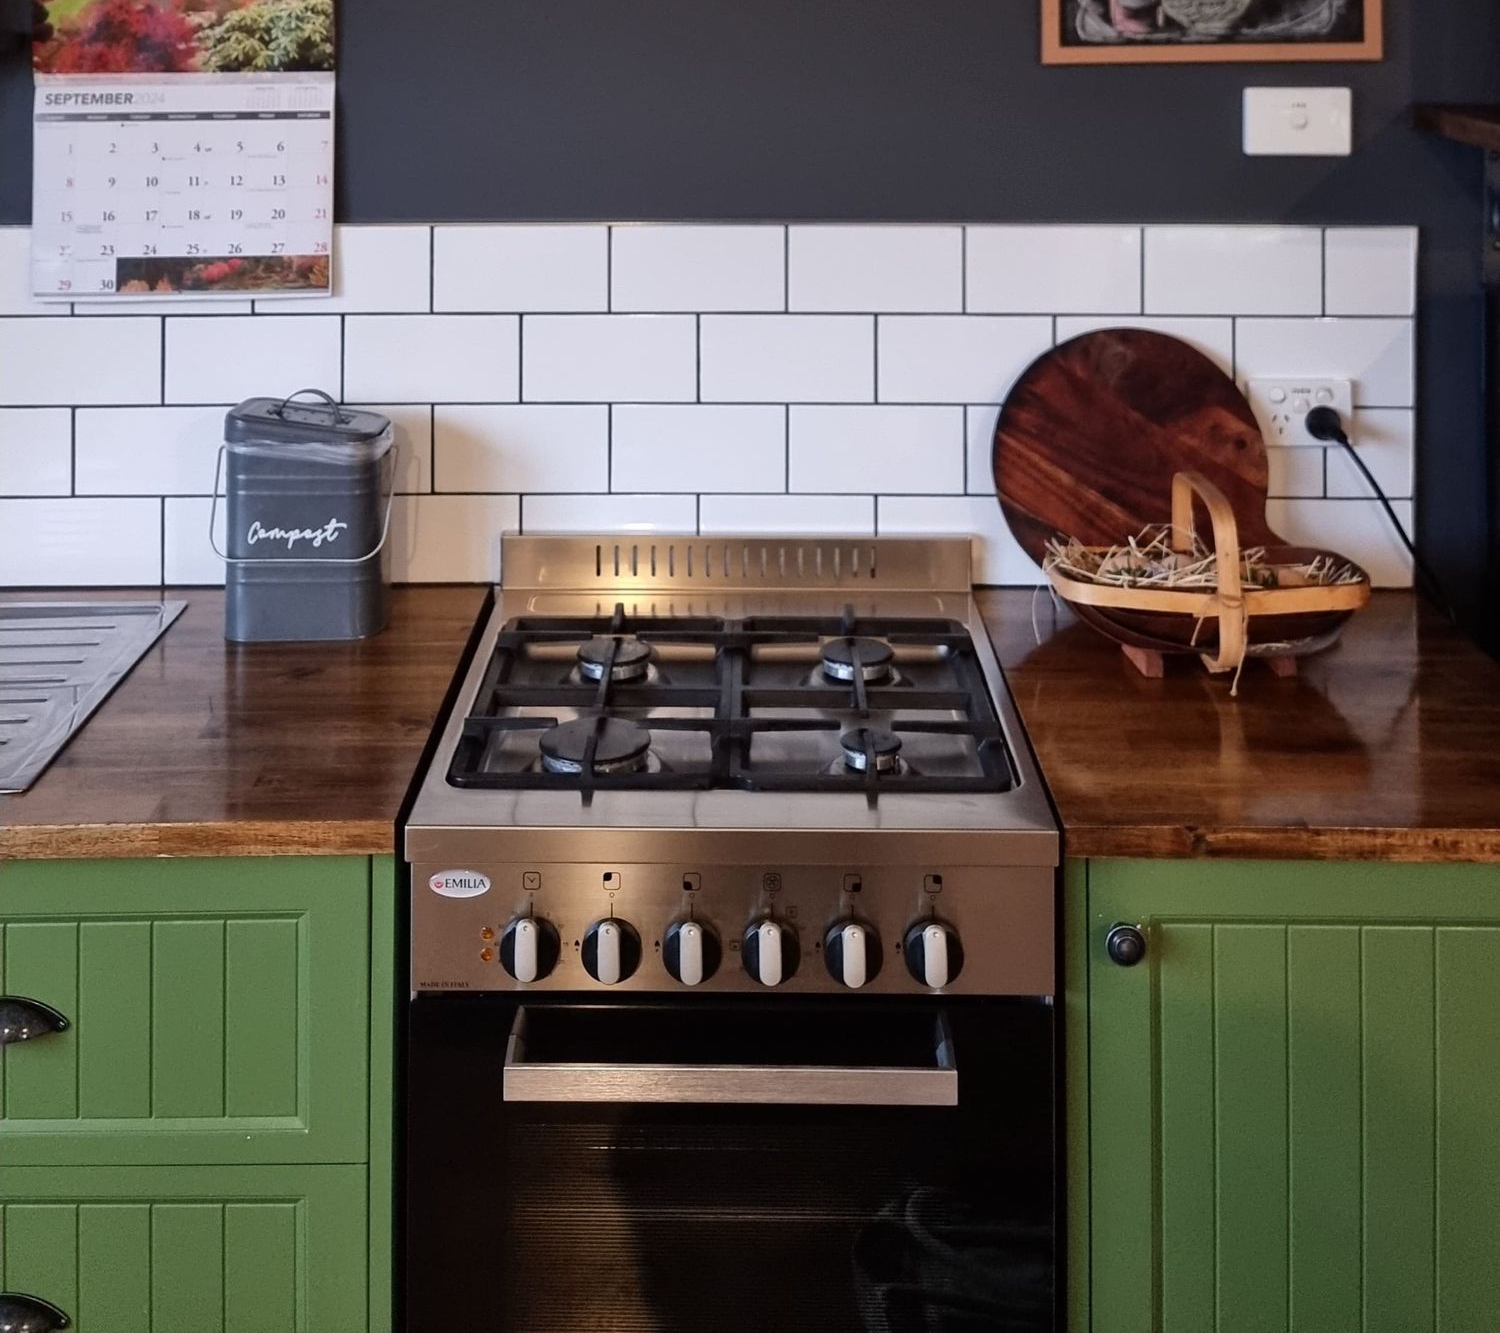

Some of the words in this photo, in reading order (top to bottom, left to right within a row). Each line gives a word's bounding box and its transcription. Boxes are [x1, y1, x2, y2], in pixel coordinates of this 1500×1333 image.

[44, 92, 134, 106] SEPTEMBER
[109, 142, 117, 154] 2
[151, 142, 159, 154] 3
[193, 142, 201, 153] 4
[236, 141, 244, 153] 5
[276, 141, 285, 152] 6
[66, 177, 75, 188] 8
[108, 177, 116, 188] 9
[145, 176, 159, 188] 10
[188, 175, 200, 187] 11
[230, 174, 244, 187] 12
[273, 174, 286, 187] 13
[315, 174, 329, 186] 14
[60, 211, 73, 223] 15
[102, 210, 116, 223] 16
[145, 210, 159, 222] 17
[187, 209, 201, 221] 18
[230, 209, 243, 221] 19
[271, 208, 286, 220] 20
[315, 208, 327, 220] 21
[100, 244, 115, 257] 23
[142, 244, 157, 256] 24
[185, 243, 200, 255] 25
[227, 242, 243, 255] 26
[271, 242, 285, 255] 27
[313, 241, 329, 254] 28
[57, 279, 73, 292] 29
[99, 279, 115, 291] 30
[247, 517, 348, 551] Compost
[445, 878, 487, 889] EMILIA
